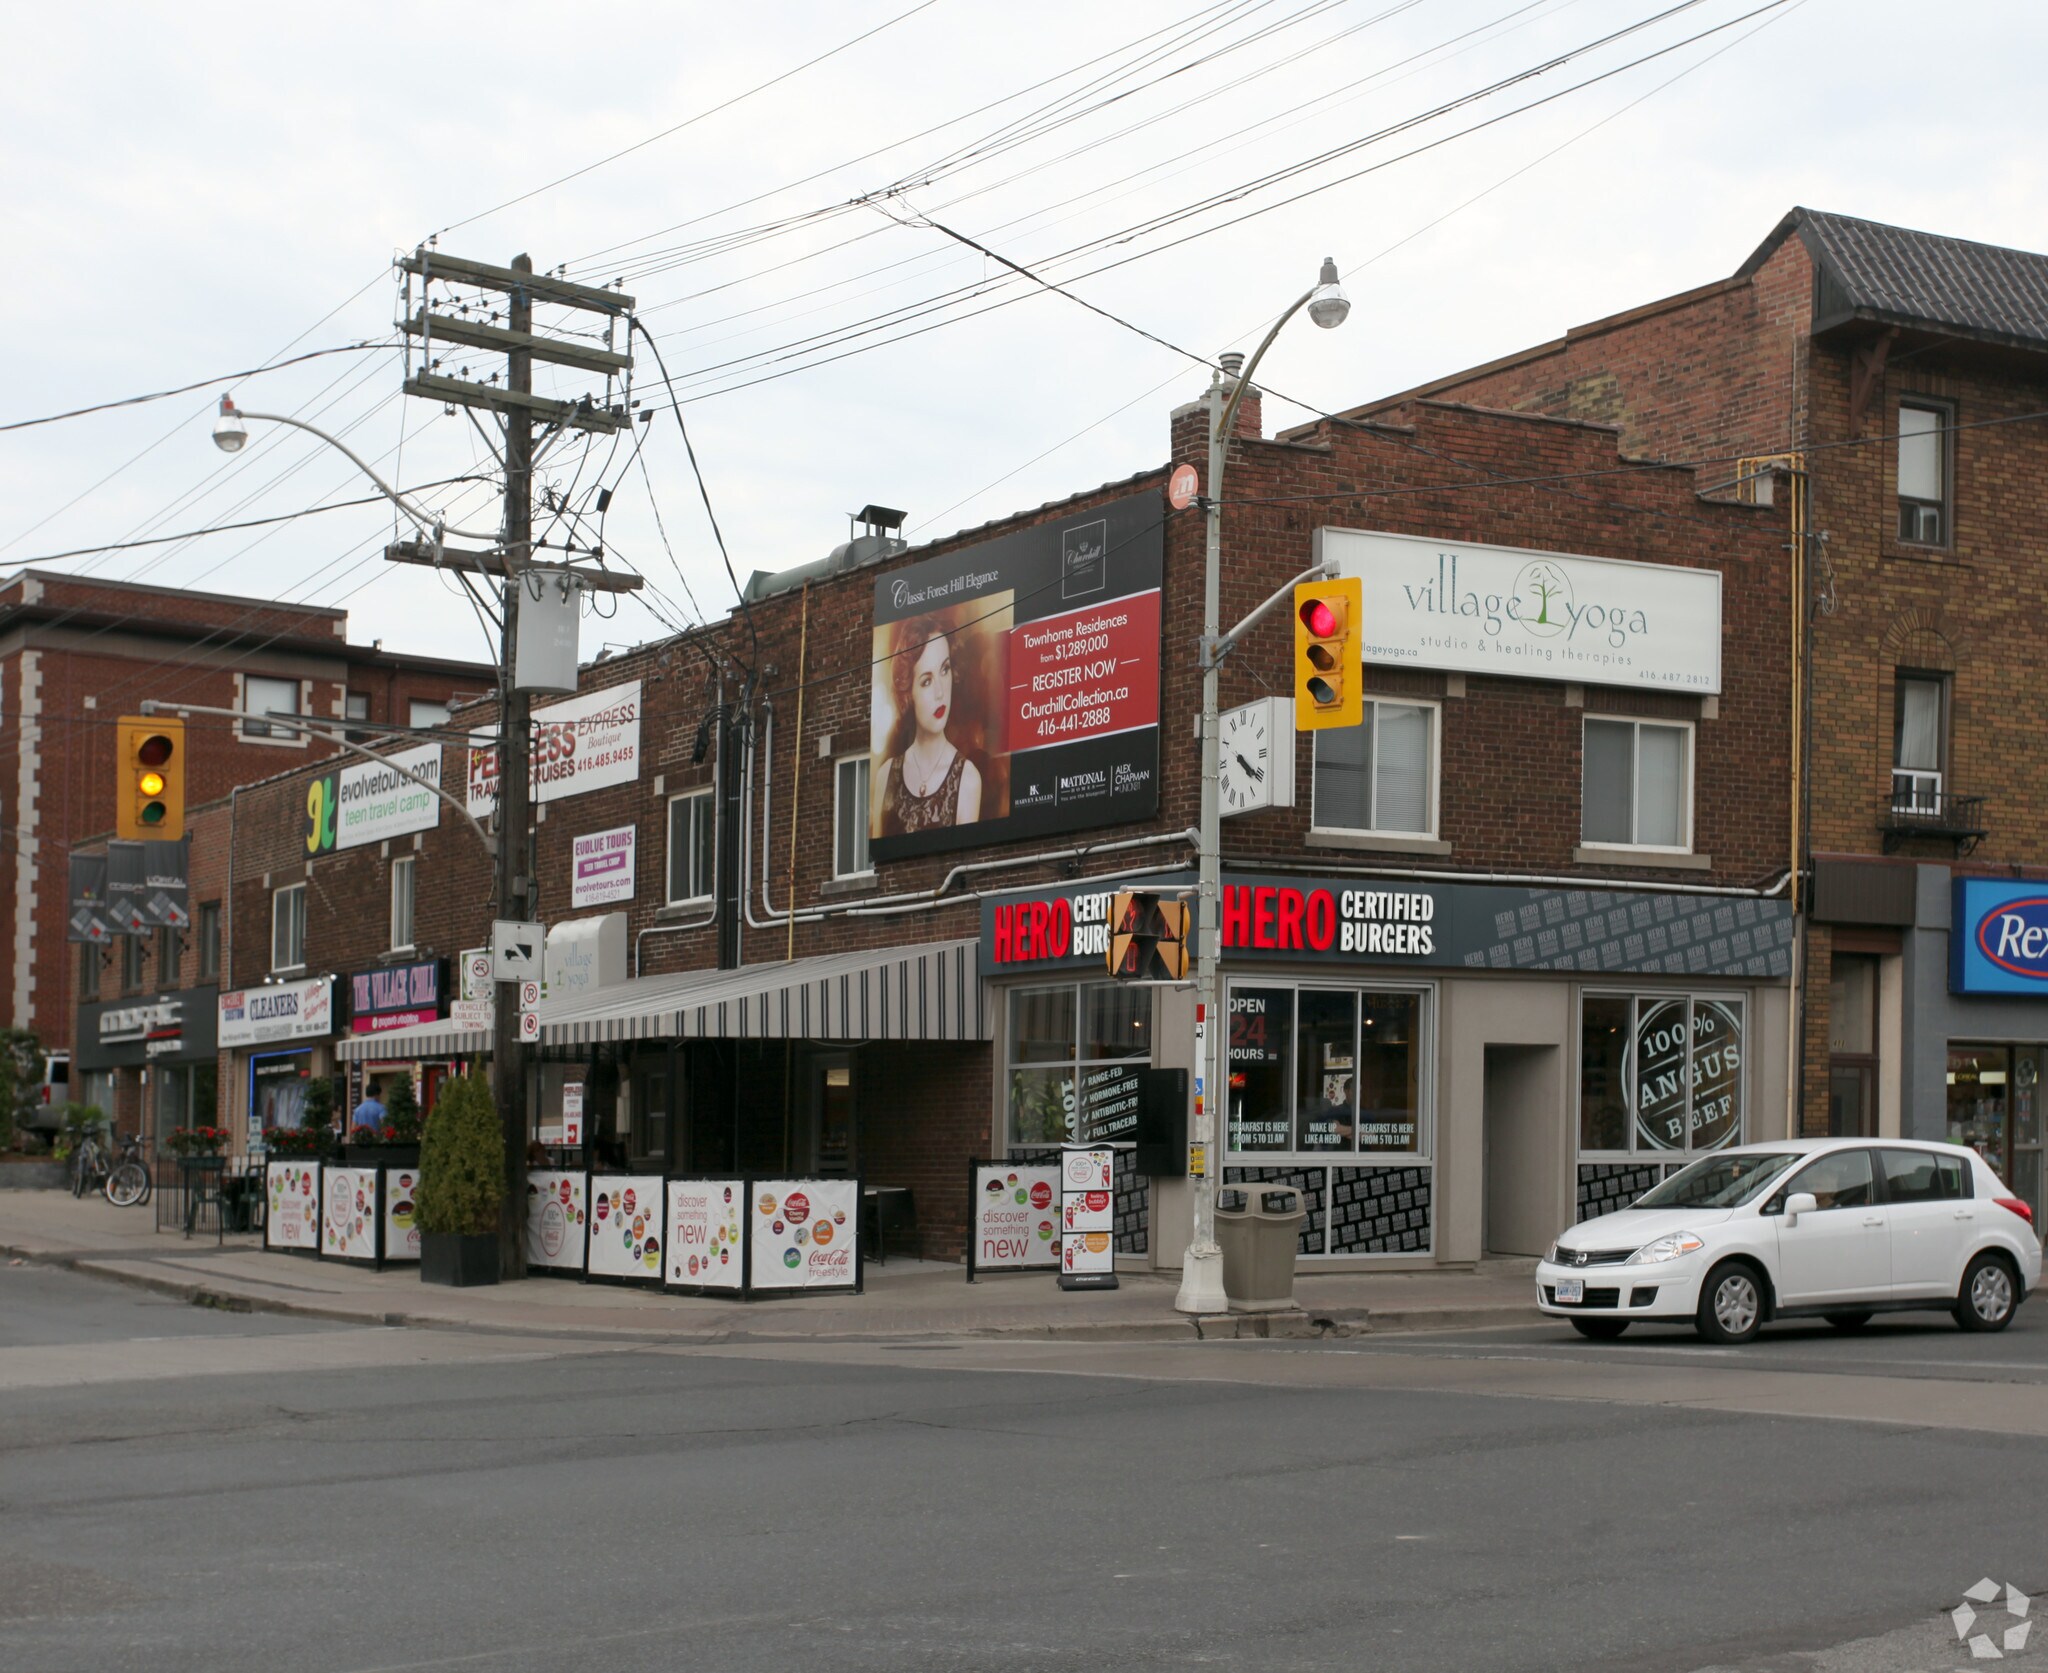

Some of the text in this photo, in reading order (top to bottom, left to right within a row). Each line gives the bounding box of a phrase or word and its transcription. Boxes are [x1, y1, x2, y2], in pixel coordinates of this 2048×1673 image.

[891, 570, 999, 609] Classic Forest Hill Elegance
[1402, 553, 1648, 649] village yoga
[1023, 614, 1127, 648] Townhome Residences
[1040, 633, 1108, 663] from $1,289,000
[1420, 636, 1632, 666] studio & healing therapies
[1032, 657, 1117, 692] REGISTER NOW
[1639, 670, 1710, 685] 416.487.2812
[1021, 686, 1128, 720] ChurchillCollection.ca
[577, 703, 635, 737] EXPRESS
[1037, 706, 1110, 736] 416-441-2888
[588, 732, 622, 749] Boutique
[577, 746, 634, 773] 416.485.9455
[1115, 764, 1131, 775] ALEX
[1060, 770, 1106, 789] NATIONAL
[1115, 770, 1150, 784] CHAPMAN
[469, 778, 501, 801] TRAV
[345, 791, 430, 826] teen travel camp
[575, 831, 632, 856] EVOLVE TOURS
[575, 877, 631, 894] evolvetours.com
[994, 891, 1112, 963] HERO CERT
[1221, 884, 1434, 951] HERO CERTIFIED
[1073, 923, 1112, 955] BURG
[1340, 922, 1433, 955] BURGERS
[565, 943, 592, 971] village
[353, 974, 371, 1012] THE
[371, 968, 408, 1010] VILLAGE
[409, 964, 436, 1005] CHILL
[567, 973, 589, 991] yoga
[249, 993, 298, 1021] CLEANERS
[458, 1003, 488, 1011] VEHICLES
[1229, 998, 1266, 1013] OPEN
[454, 1012, 492, 1020] SUBJECT TO
[461, 1021, 484, 1029] TOWING
[1231, 1014, 1267, 1046] 24
[1643, 1012, 1715, 1058] 100%
[1229, 1048, 1264, 1060] HOURS
[1087, 1067, 1122, 1087] RANGE-FED
[1640, 1044, 1740, 1109] ANGUS
[1089, 1078, 1138, 1103] HORMONE-FREE
[1091, 1096, 1138, 1121] ANTIBIOTIC-FR
[1665, 1094, 1732, 1139] BEEF
[1092, 1115, 1137, 1138] FULL TRACEAB
[1265, 1122, 1272, 1132] IS
[1273, 1121, 1289, 1132] HERE
[1309, 1123, 1336, 1132] WAKE UP
[1391, 1123, 1398, 1133] IS
[1399, 1123, 1414, 1133] HERE
[1252, 1133, 1257, 1143] 5
[1258, 1133, 1267, 1143] TO
[1274, 1133, 1285, 1143] AM
[1304, 1134, 1341, 1144] LIKE A HERO
[1361, 1135, 1378, 1145] FROM
[1379, 1135, 1384, 1145] 5
[1384, 1135, 1393, 1145] TO
[1400, 1135, 1410, 1144] AM
[677, 1194, 708, 1208] discover
[677, 1210, 708, 1223] something
[983, 1208, 1029, 1223] discover
[282, 1222, 300, 1240] new
[677, 1224, 707, 1244] new
[983, 1223, 1029, 1237] something
[808, 1249, 849, 1266] Coca-Cola
[984, 1238, 1029, 1258] new
[808, 1266, 848, 1278] freestyle
